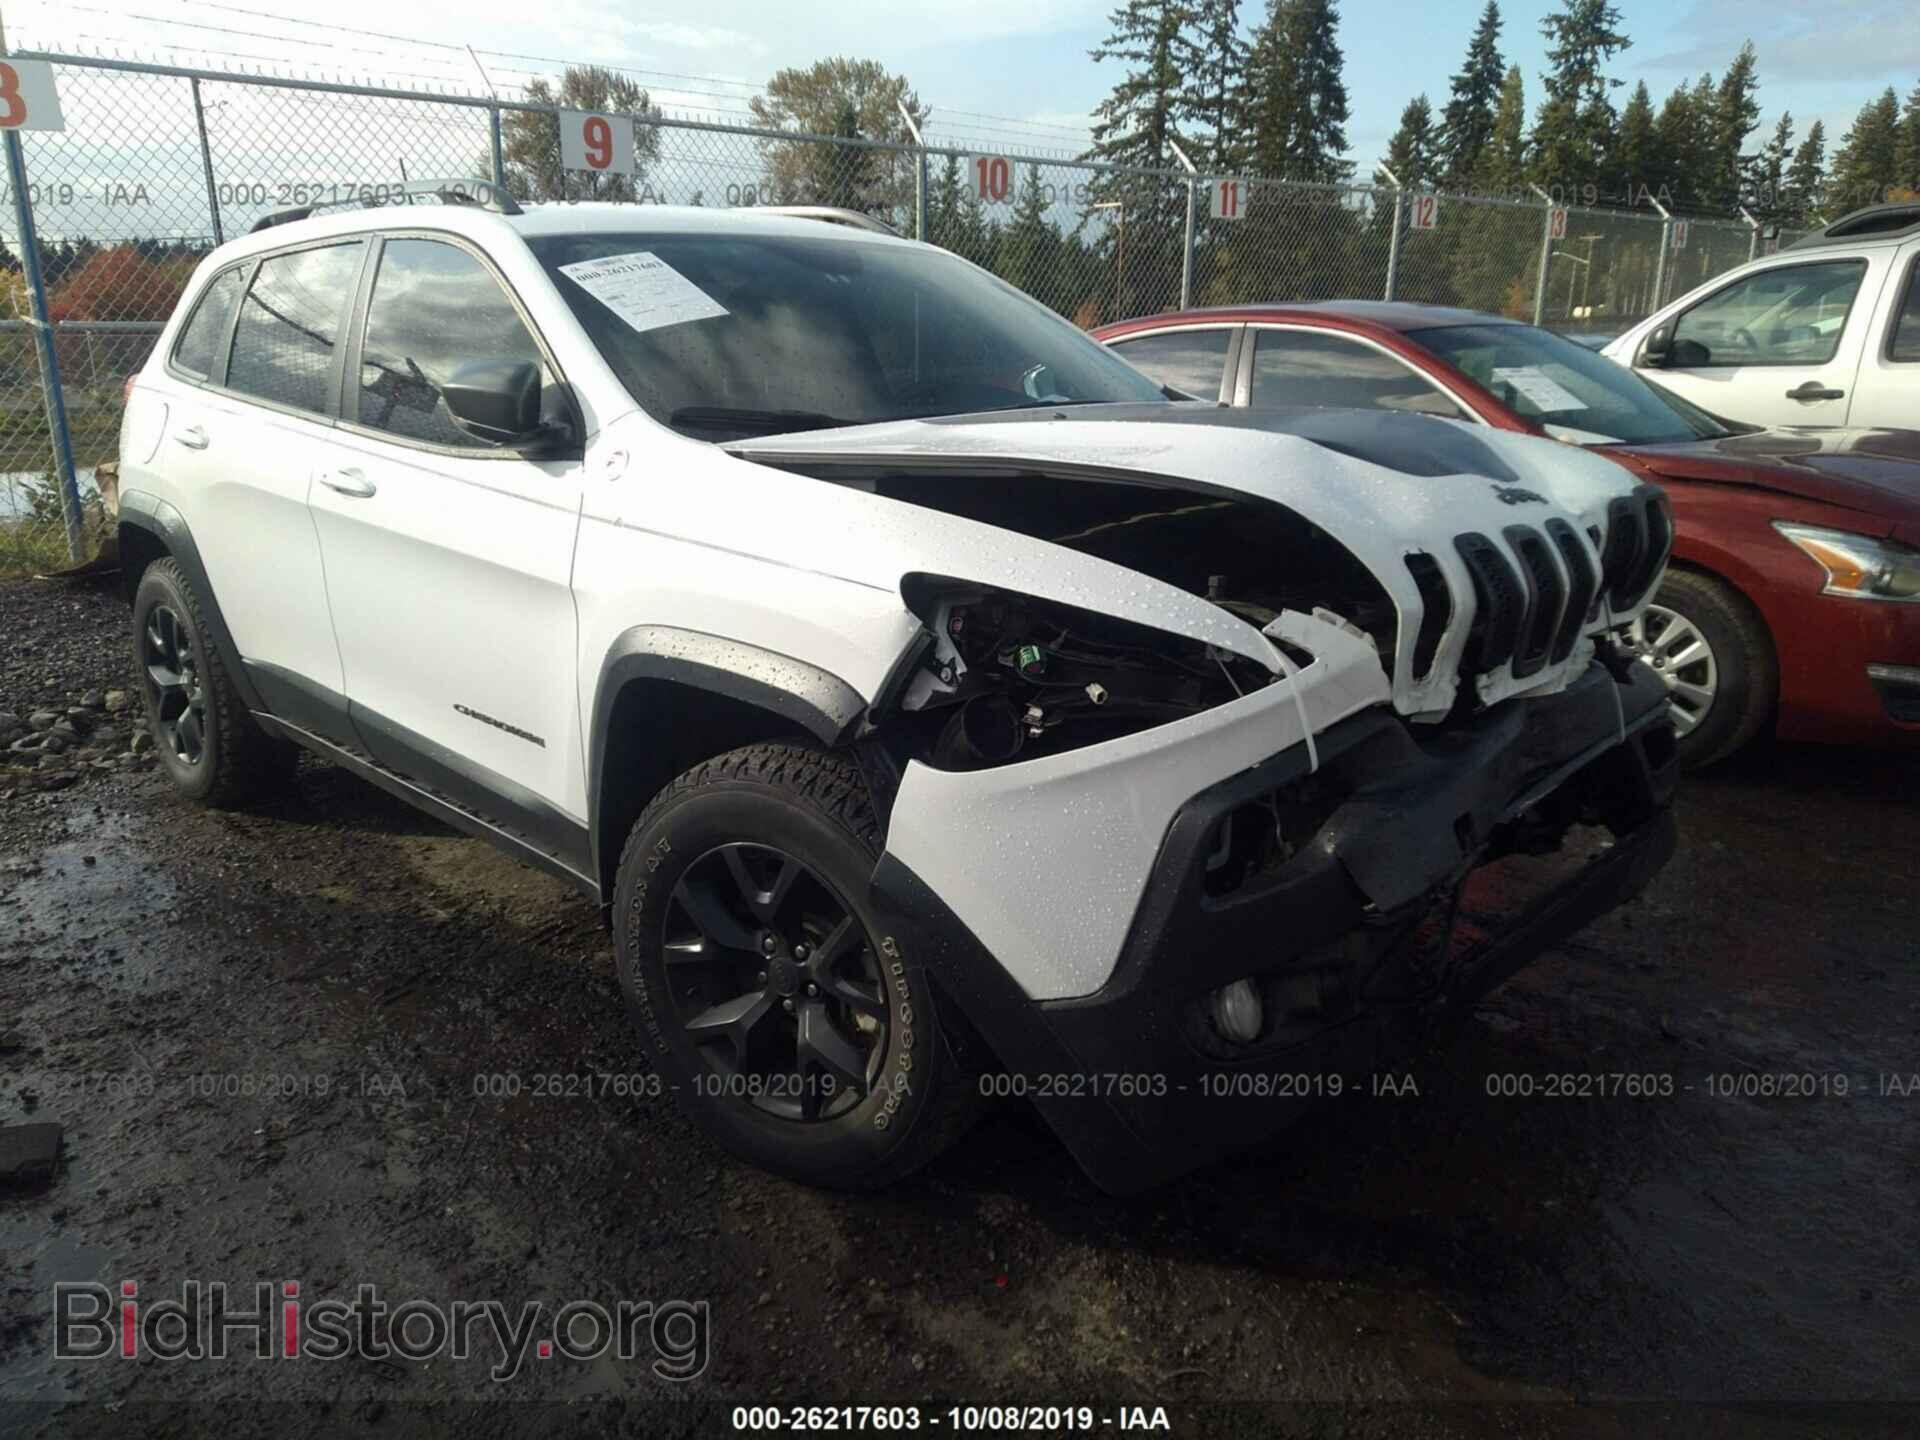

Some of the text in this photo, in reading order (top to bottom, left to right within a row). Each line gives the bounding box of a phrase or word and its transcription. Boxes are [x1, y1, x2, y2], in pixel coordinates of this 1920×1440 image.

[583, 116, 613, 169] 9
[976, 156, 1009, 200] 10
[1220, 181, 1238, 217] 11
[1415, 197, 1434, 227] 12
